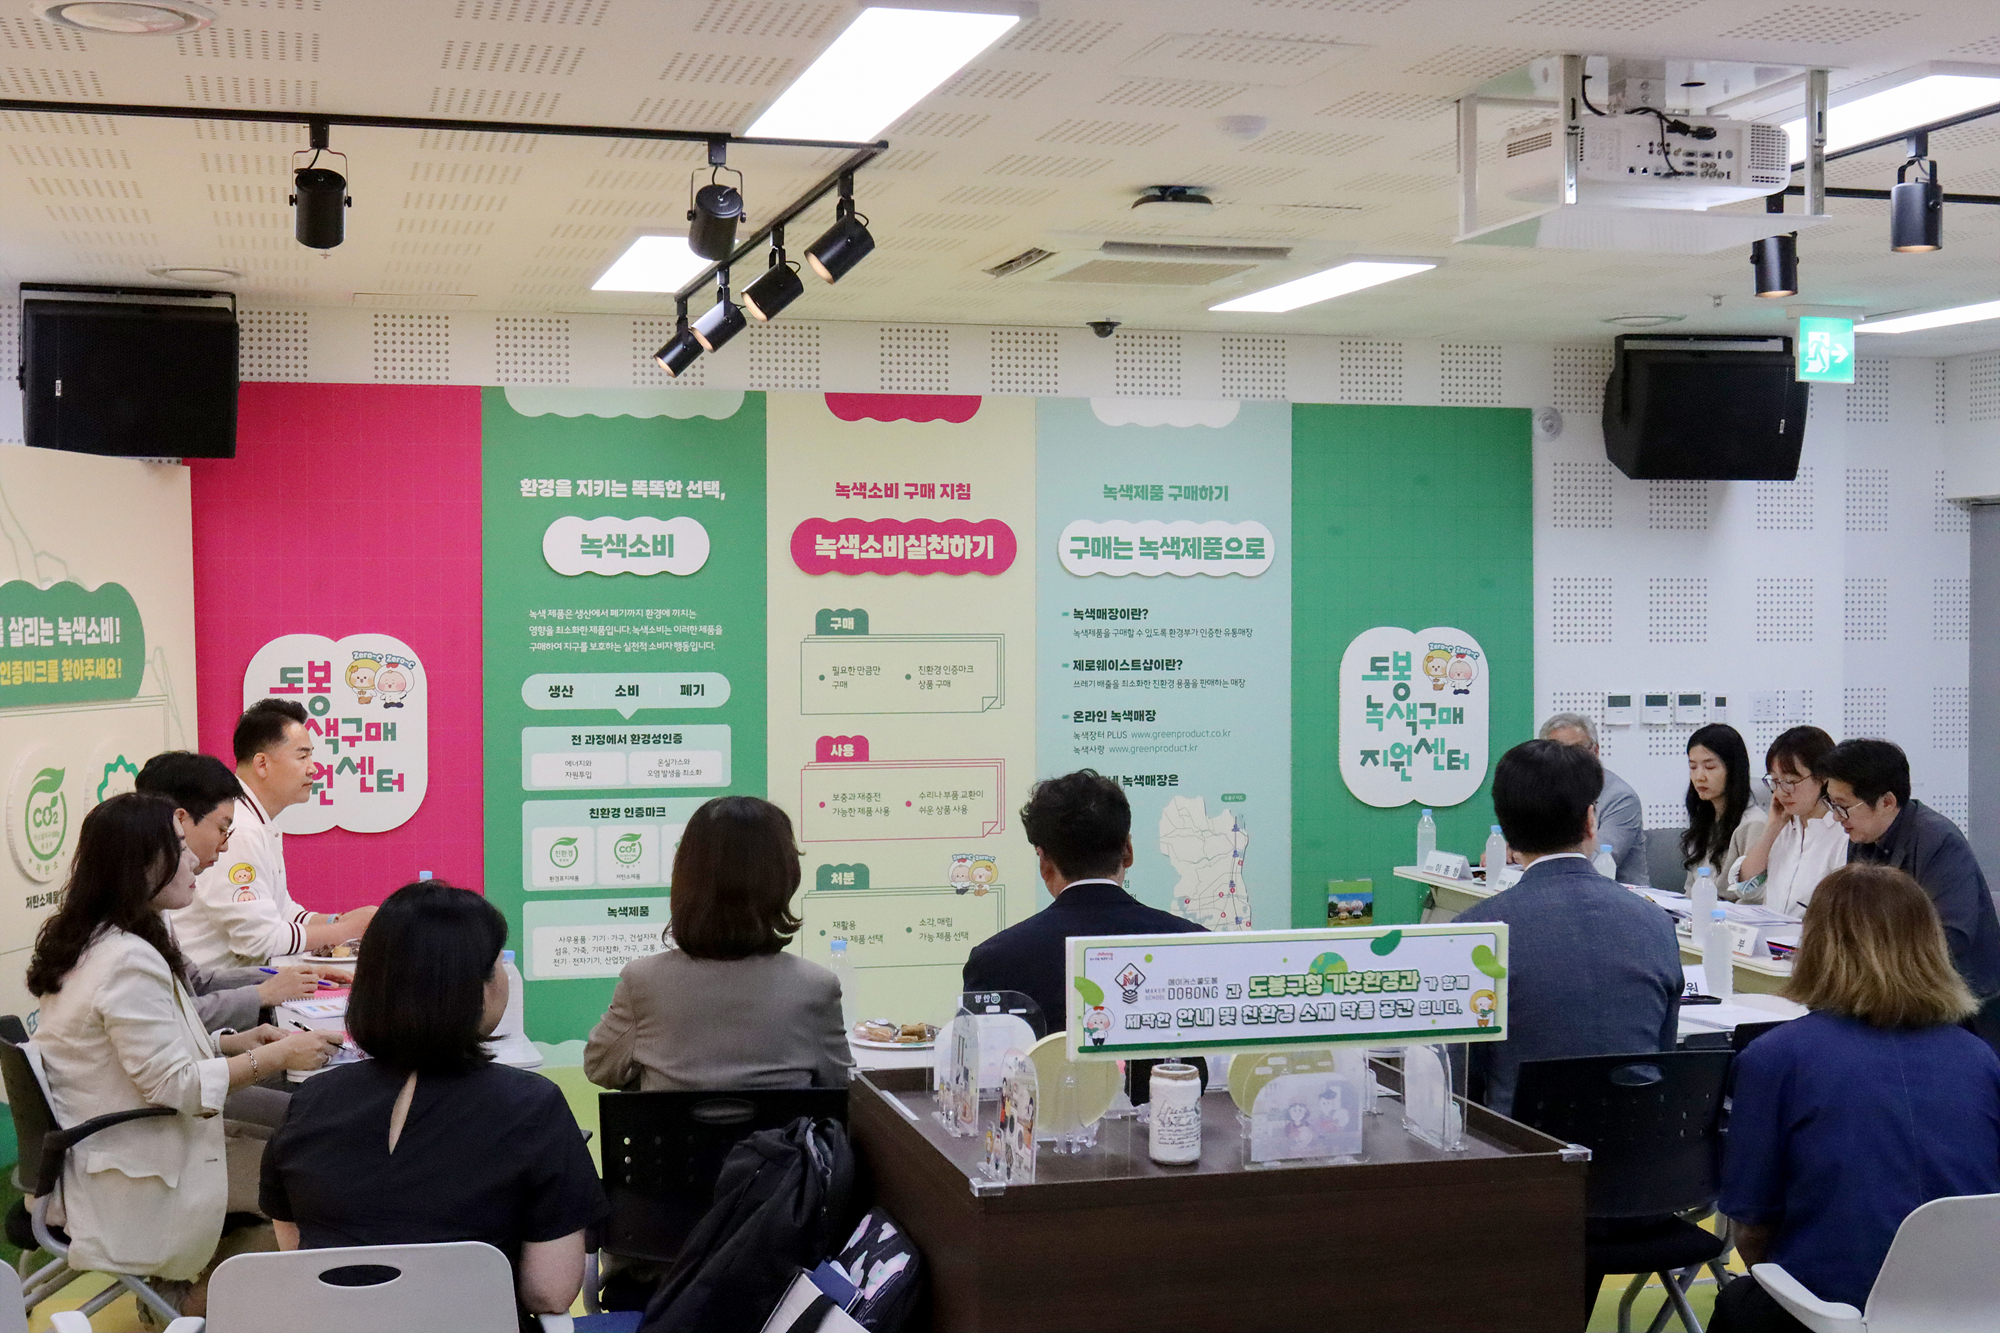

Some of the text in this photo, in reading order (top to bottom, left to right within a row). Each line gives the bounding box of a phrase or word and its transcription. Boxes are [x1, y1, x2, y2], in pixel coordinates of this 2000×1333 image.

[520, 478, 726, 500] 환경을 지키는 똑똑한 선택,
[835, 481, 971, 500] 녹색소비 구매 지침
[1103, 484, 1229, 501] 녹색제품 구매하기
[580, 533, 674, 558] 녹색소비
[814, 533, 994, 559] 녹색소비실천하기
[1070, 535, 1266, 560] 구매는 녹색제품으로
[529, 608, 697, 620] 녹색 제품은 생산에서 폐기까지 환경에 끼치는
[1073, 607, 1149, 621] 녹색매장이란?
[830, 617, 854, 630] 구매
[8, 616, 54, 647] 살리는
[58, 616, 120, 645] 녹색소비!
[529, 626, 554, 636] 영향을
[555, 626, 588, 636] 최소화한
[632, 626, 672, 636] 녹색소비는
[674, 625, 697, 635] 이러한
[698, 625, 723, 635] 제품을
[1073, 628, 1253, 638] 녹색제품을 구매할 수 있도록 환경부가 인증한 유통매장
[529, 642, 562, 652] 구매하여
[564, 642, 588, 652] 지구를
[590, 642, 622, 652] 보호하는
[624, 642, 648, 652] 실천적
[650, 642, 673, 651] 소비자
[61, 658, 122, 682] 찾아주세요!
[832, 665, 881, 676] 필요한 만큼만
[918, 665, 974, 675] 친환경 인증마크
[1073, 659, 1183, 671] 제로웨이스트샵이란?
[1362, 651, 1411, 701] 도봉
[269, 661, 331, 716] 도봉
[615, 684, 640, 697] 소비
[680, 684, 705, 697] 폐기
[832, 681, 848, 689] 구매
[918, 680, 951, 690] 상품 구매
[1073, 679, 1246, 689] 쓰레기 배출을 최소화한 친환경 용품을 판매하는 매장
[548, 685, 574, 698] 생산
[1073, 709, 1156, 722] 온라인 녹색매장
[1366, 694, 1464, 736] 녹색구매
[303, 717, 396, 755] 색구매
[571, 733, 683, 746] 전 과정에서 환경성인증
[1073, 729, 1231, 740] 녹색장터 PLUS www.greenproduct.co.kr
[830, 744, 854, 757] 사용
[1109, 744, 1198, 754] www.greenproduct.kr
[658, 759, 690, 767] 온실가스와
[1360, 737, 1469, 782] 지원센터
[565, 771, 592, 779] 자원투입
[1122, 774, 1179, 787] 녹색매장은
[919, 790, 984, 800] 수리나 부품 교환이
[589, 807, 666, 818] 친환경 인증마크
[832, 806, 890, 817] 가능한 제품 사용
[919, 804, 968, 815] 쉬운 상품 사용
[831, 872, 854, 885] 처분
[607, 906, 649, 917] 녹색제품
[832, 920, 856, 930] 재활용
[559, 935, 586, 944] 사무용품
[850, 934, 865, 944] 제품
[868, 934, 884, 944] 선택
[919, 931, 969, 942] 가능 제품 선택
[1226, 969, 1469, 999] 과 도봉구청 기후환경과 가 함께
[1168, 986, 1219, 1000] DOBONG
[1125, 999, 1462, 1029] 제작한 안내 및 친환경 소재 작품 공간 입니다.
